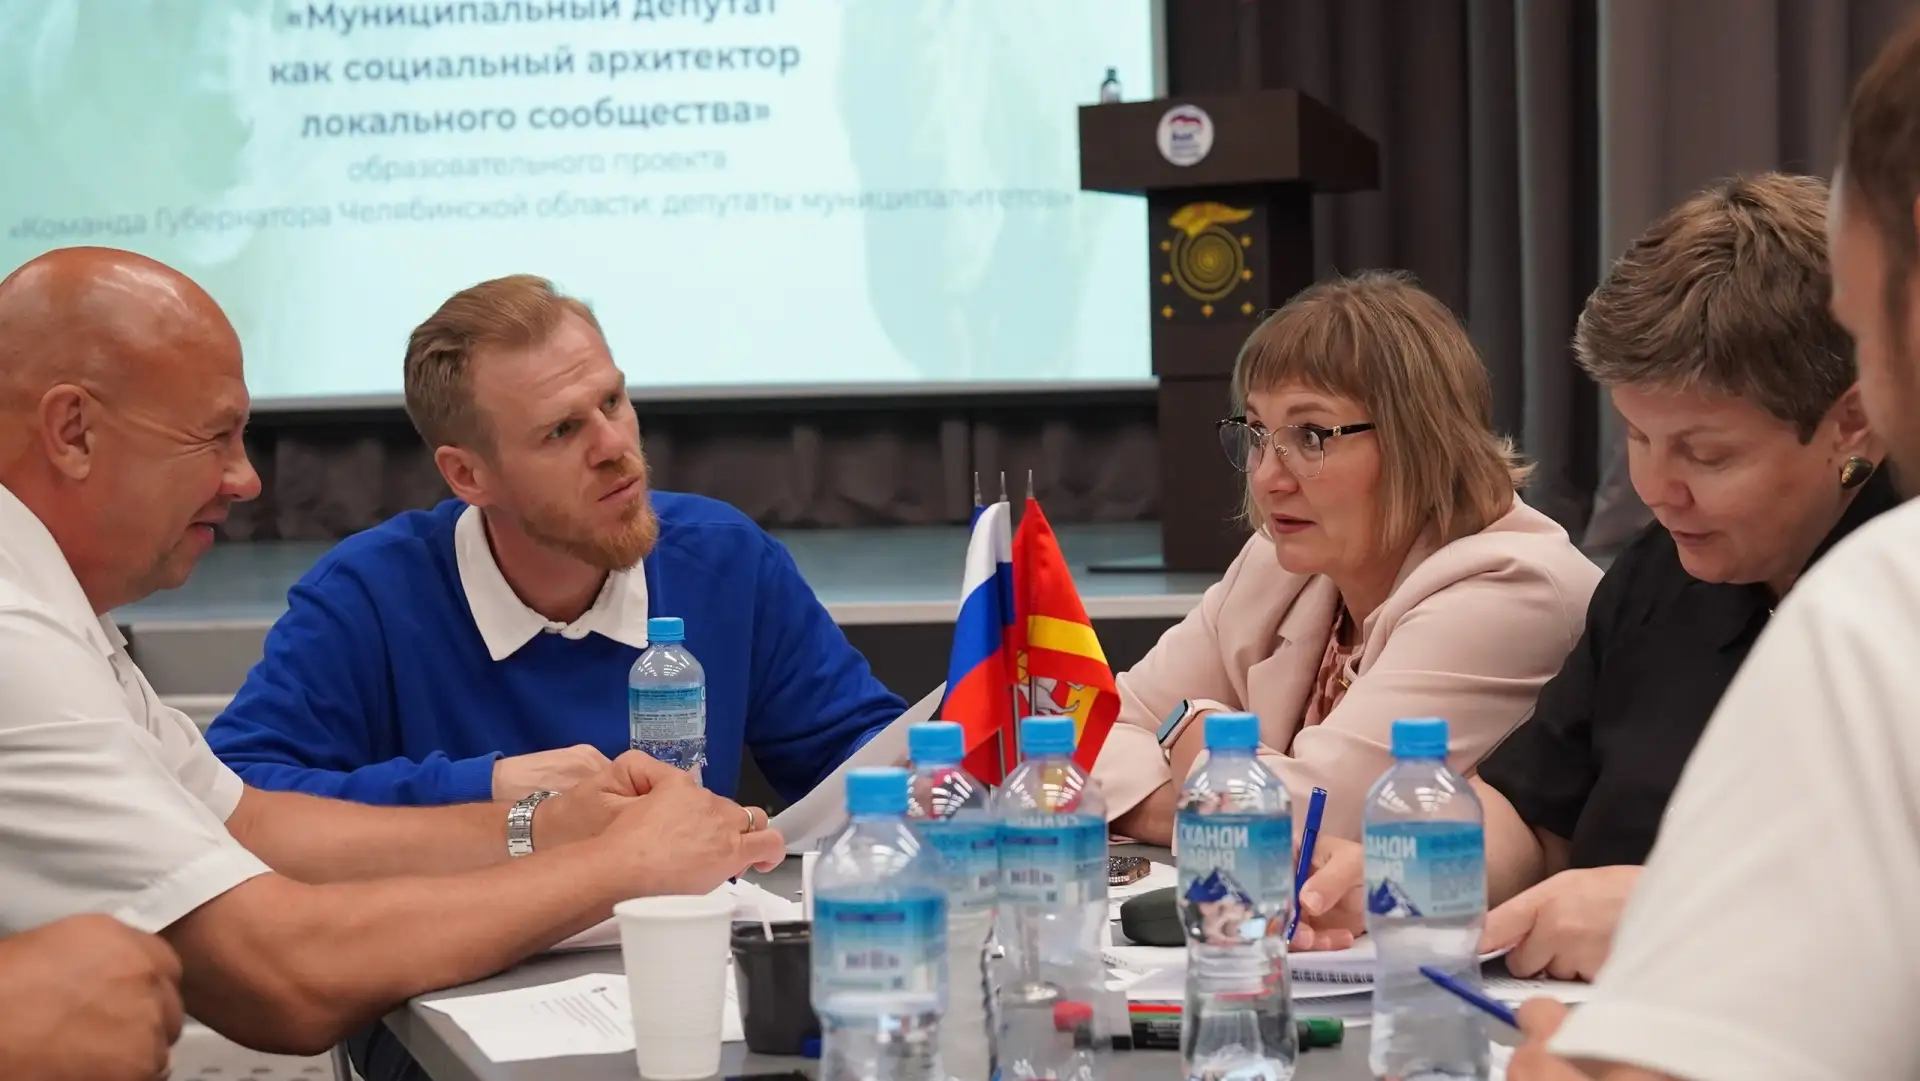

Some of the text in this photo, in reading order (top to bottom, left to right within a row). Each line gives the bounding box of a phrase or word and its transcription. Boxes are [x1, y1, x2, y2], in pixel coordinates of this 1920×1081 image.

[286, 0, 779, 34] «Муниципальный депутат
[270, 43, 801, 85] как социальный архитектор
[301, 97, 771, 138] локального сообщества»
[347, 149, 727, 183] образовательного проекта
[8, 212, 147, 240] «Команда
[154, 202, 332, 238] Губернатора
[339, 196, 528, 224] Челябинской
[662, 192, 793, 218] депутаты
